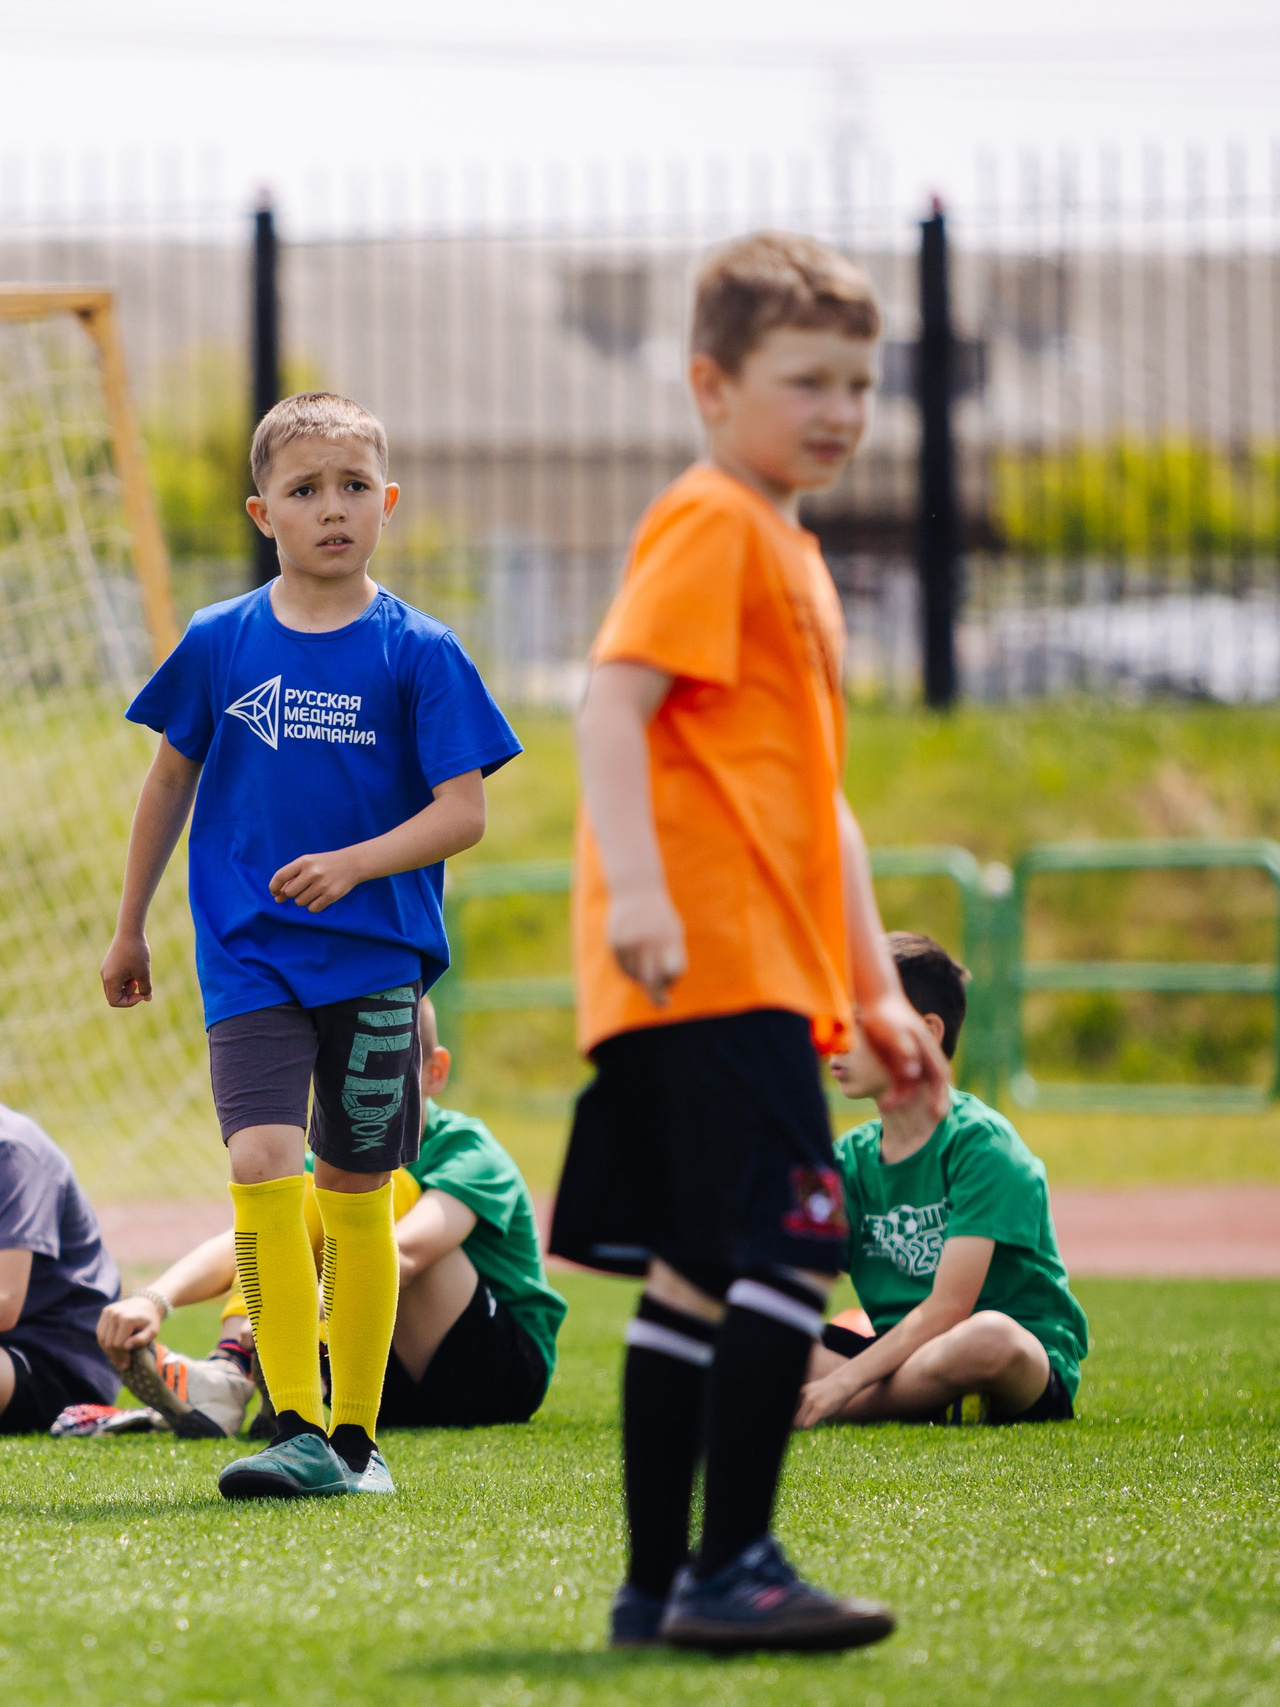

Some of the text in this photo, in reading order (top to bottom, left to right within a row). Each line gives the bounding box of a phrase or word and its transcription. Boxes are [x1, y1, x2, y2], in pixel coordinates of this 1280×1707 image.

[284, 688, 362, 712] РУССКАЯ
[283, 706, 357, 728] МЕДНАЯ
[283, 723, 377, 746] КОМПАНИЯ
